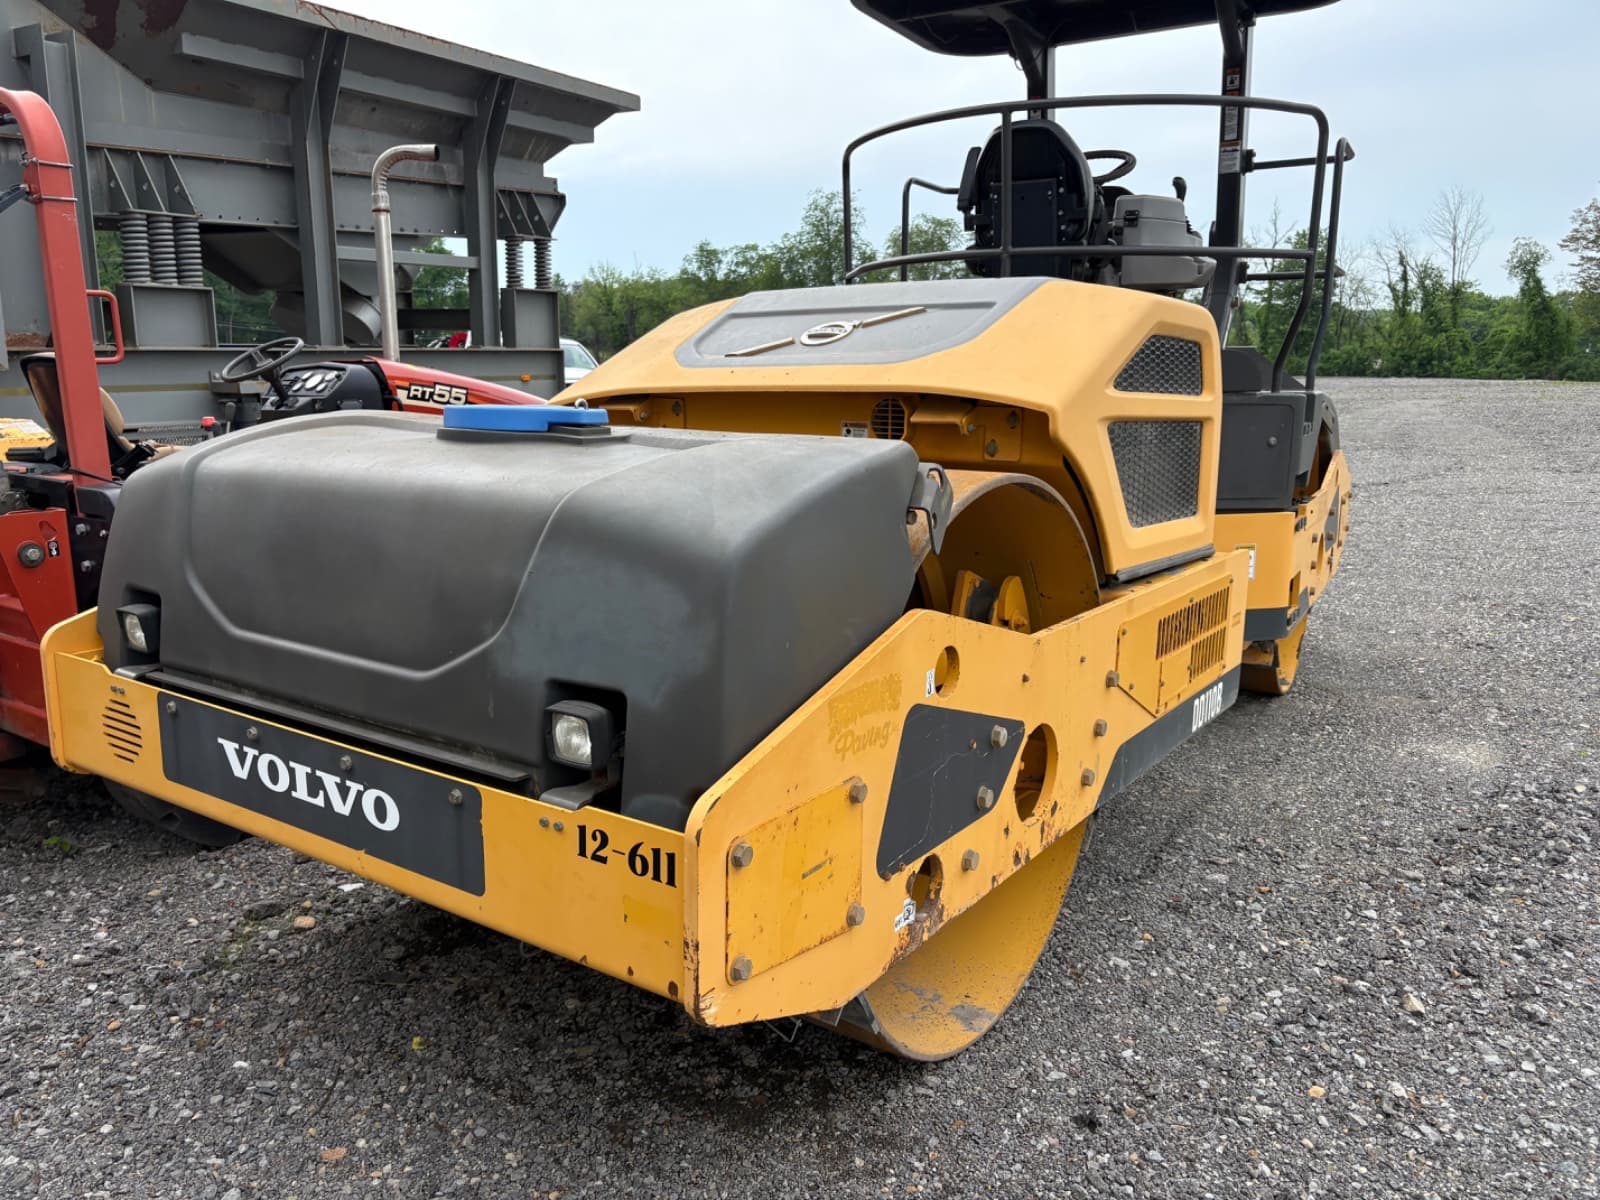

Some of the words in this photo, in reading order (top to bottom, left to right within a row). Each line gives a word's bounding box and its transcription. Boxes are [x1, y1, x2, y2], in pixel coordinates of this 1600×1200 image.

[408, 383, 468, 405] RT55
[217, 737, 400, 832] VOLVO
[577, 824, 677, 888] 12-611
